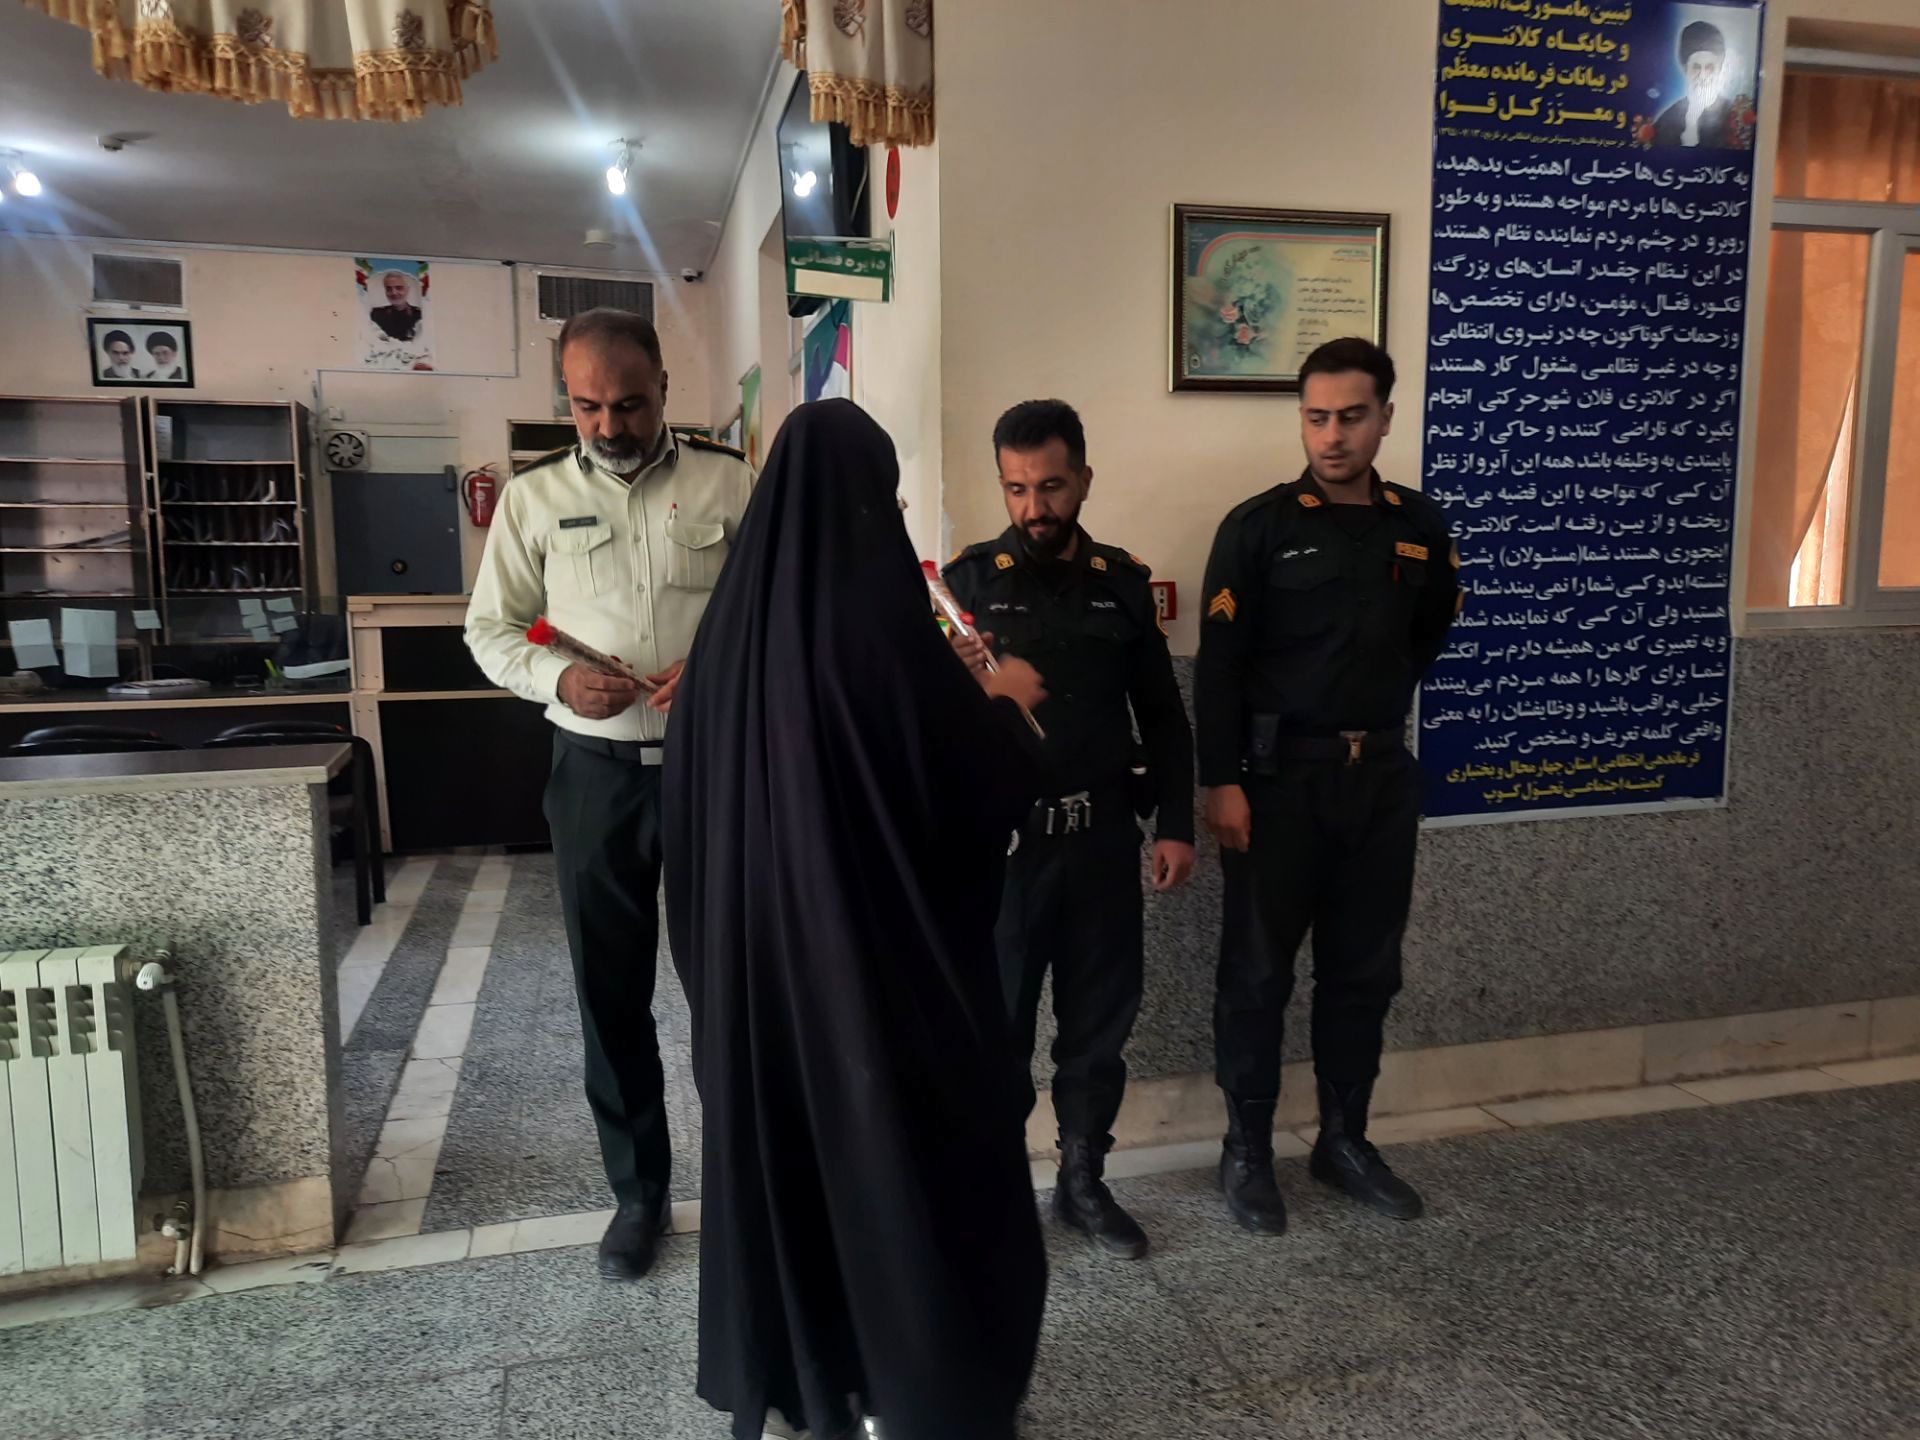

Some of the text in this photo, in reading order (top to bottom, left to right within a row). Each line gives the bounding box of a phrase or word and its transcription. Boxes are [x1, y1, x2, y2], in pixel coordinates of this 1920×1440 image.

[1442, 26, 1630, 61] و جایگاه کلانتری
[1556, 66, 1605, 92] بیانات
[1607, 74, 1628, 94] در
[1440, 91, 1496, 118] قوا
[1499, 95, 1542, 120] کل
[1616, 112, 1626, 128] و
[1572, 160, 1632, 184] خیلی
[1734, 173, 1748, 190] به
[1435, 188, 1471, 212] طور
[1474, 192, 1489, 210] به
[1491, 194, 1502, 212] و
[1504, 194, 1554, 208] هستند
[1558, 194, 1606, 218] مواجه
[1608, 200, 1646, 220] مردم
[1650, 198, 1659, 218] با
[1494, 224, 1530, 246] نظام
[1534, 226, 1592, 247] نماینده
[1595, 232, 1634, 252] مردم
[1638, 230, 1675, 252] چشم
[1680, 235, 1698, 250] در
[1587, 262, 1640, 283] چقدر
[1646, 262, 1687, 284] نظام
[1693, 265, 1720, 286] این
[1724, 269, 1742, 284] در
[1528, 292, 1576, 312] دارای
[1431, 322, 1738, 349] و زحمات گوناگون چه در نیروی انتظامی
[1490, 356, 1518, 376] کار
[1522, 356, 1577, 380] مشغول
[1582, 358, 1638, 380] نظامی
[1642, 358, 1676, 380] غیر
[1680, 362, 1698, 378] در
[1703, 363, 1724, 378] چه
[1728, 364, 1736, 380] و
[1428, 388, 1735, 412] اگر در کلانتری فلان شهر حرکتی انجام
[1428, 424, 1464, 444] عدم
[1470, 421, 1484, 441] از
[1544, 426, 1555, 442] و
[1560, 420, 1608, 436] کننده
[1612, 422, 1666, 444] ناراضی
[1672, 420, 1692, 436] که
[1697, 422, 1734, 443] بگیرد
[1426, 453, 1456, 476] نظر
[1459, 453, 1474, 473] از
[1476, 450, 1509, 476] آبرو
[1512, 453, 1540, 476] این
[1542, 456, 1574, 468] همه
[1578, 452, 1611, 472] باشد
[1614, 452, 1658, 472] وظیفه
[1661, 456, 1674, 472] به
[1498, 483, 1536, 505] قضیه
[1542, 484, 1570, 506] این
[1574, 484, 1584, 504] با
[1590, 484, 1636, 506] مواجه
[1642, 482, 1662, 498] که
[1667, 482, 1706, 504] کسی
[1710, 480, 1731, 500] آن
[1565, 514, 1604, 534] رفته
[1609, 520, 1644, 536] بین
[1649, 514, 1662, 532] از
[1666, 518, 1676, 534] و
[1680, 514, 1728, 532] ریخته
[1614, 548, 1660, 560] هستند
[1664, 544, 1728, 565] اینجوری
[1474, 579, 1502, 594] شما
[1572, 578, 1586, 596] را
[1588, 576, 1614, 592] شما
[1616, 574, 1655, 598] کسی
[1656, 579, 1665, 594] و
[1492, 602, 1726, 630] هستید ولی آن کسی که نماینده
[1482, 634, 1714, 664] به تعبیری که من همیشه دارم سر
[1550, 672, 1582, 684] همه
[1588, 668, 1600, 686] را
[1606, 666, 1646, 686] کارها
[1652, 666, 1686, 686] برای
[1691, 664, 1724, 678] شما
[1498, 674, 1544, 693] مردم
[1423, 692, 1723, 728] خیلی مراقب باشید و وظایفشان را به معنی
[1592, 726, 1640, 748] تعریف
[1642, 723, 1678, 739] کلمه
[1679, 720, 1722, 744] واقعی
[1518, 730, 1577, 754] مشخص
